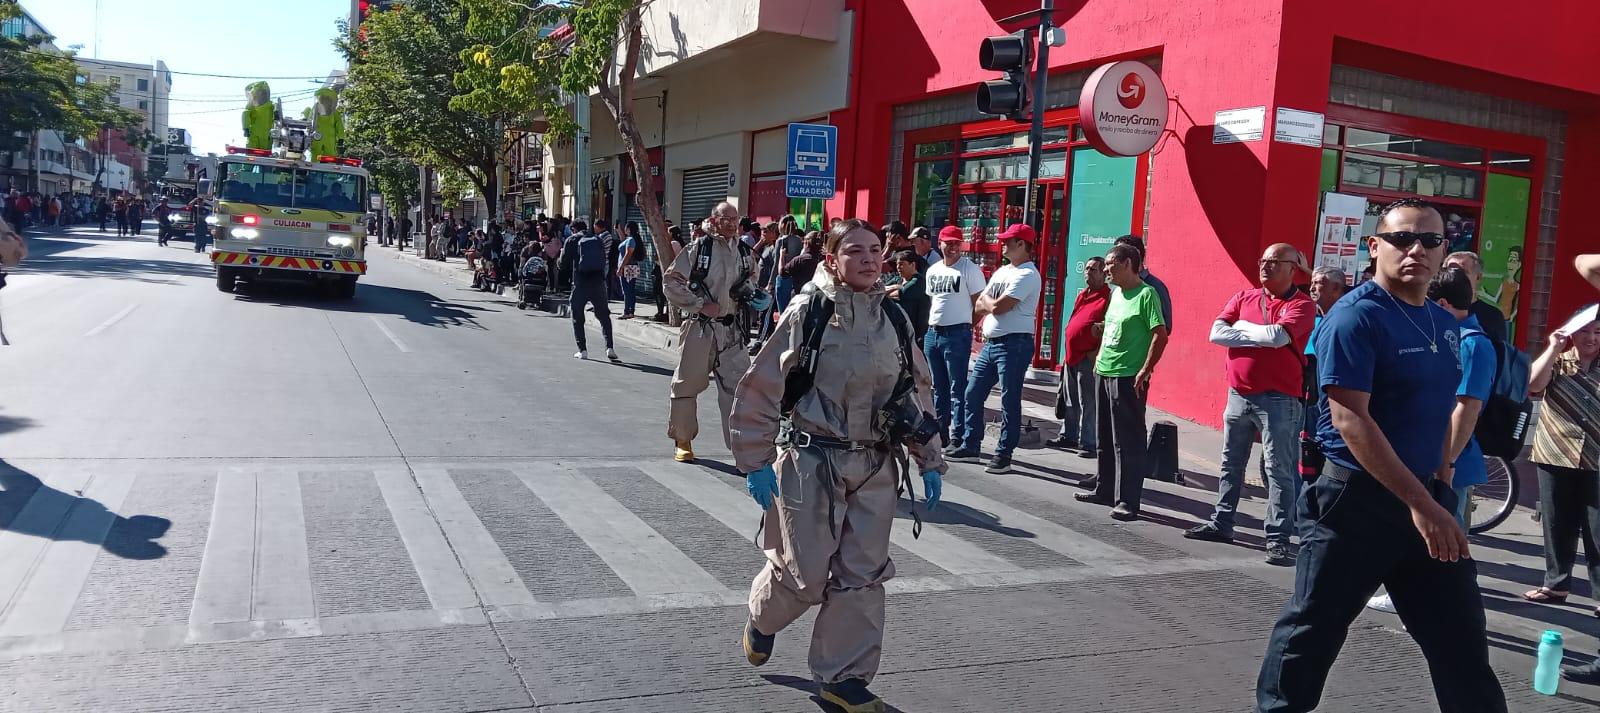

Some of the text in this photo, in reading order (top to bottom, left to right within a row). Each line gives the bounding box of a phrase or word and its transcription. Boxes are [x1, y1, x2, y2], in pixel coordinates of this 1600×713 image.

[791, 179, 831, 187] PRINCIPIA
[789, 186, 832, 195] PARADERO
[273, 219, 312, 228] CULIACAN
